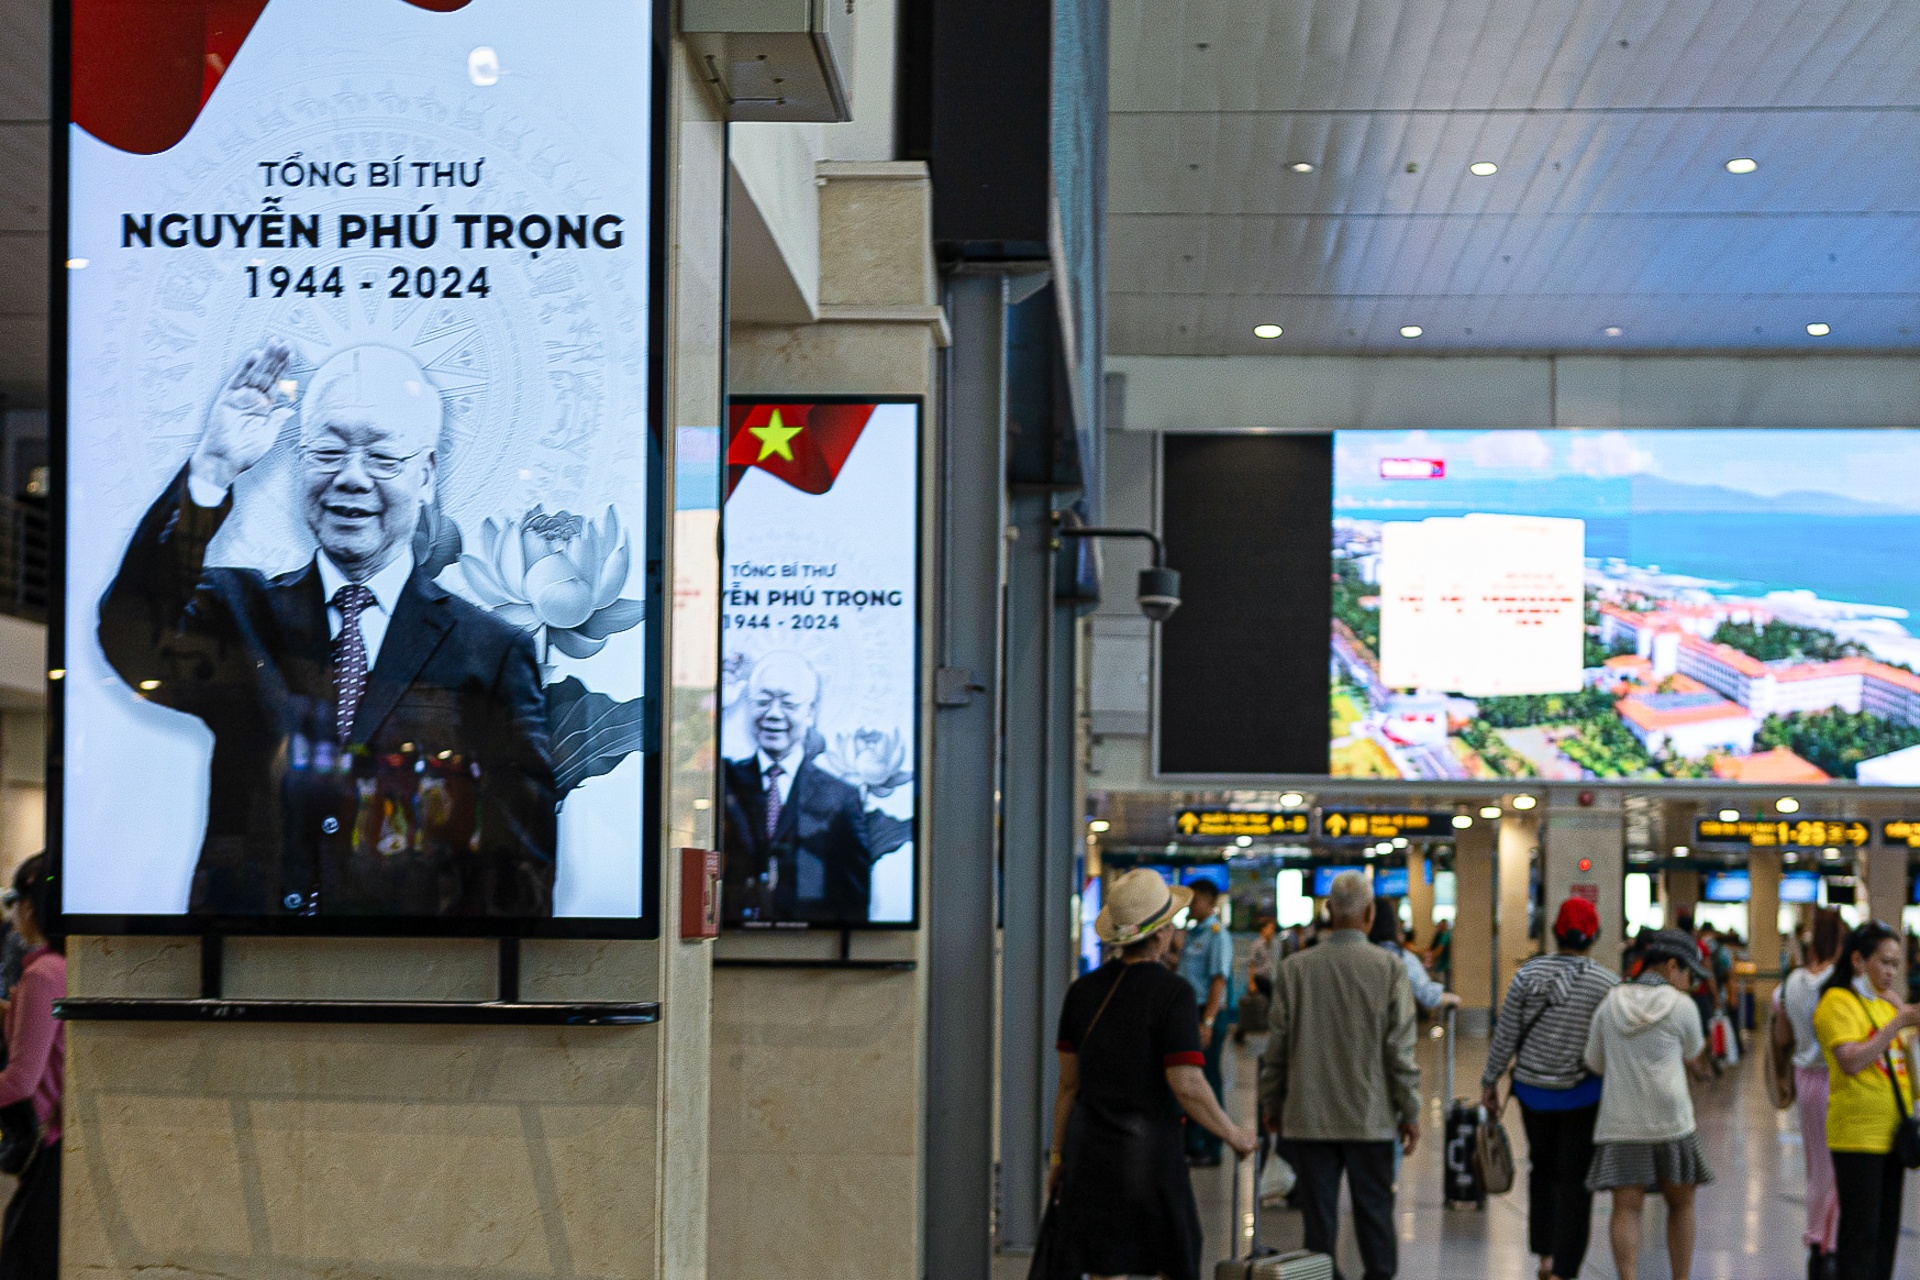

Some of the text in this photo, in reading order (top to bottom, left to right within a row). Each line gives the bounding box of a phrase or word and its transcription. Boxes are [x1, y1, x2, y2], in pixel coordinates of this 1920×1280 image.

[259, 151, 486, 188] TỔNG BÍ THƯ
[121, 197, 625, 260] NGUYỄN PHÚ TRỌNG
[245, 265, 345, 299] 1944
[388, 265, 491, 299] 2024
[767, 585, 815, 607] PHÚ
[822, 589, 903, 612] TRỌNG
[791, 614, 840, 630] 2024
